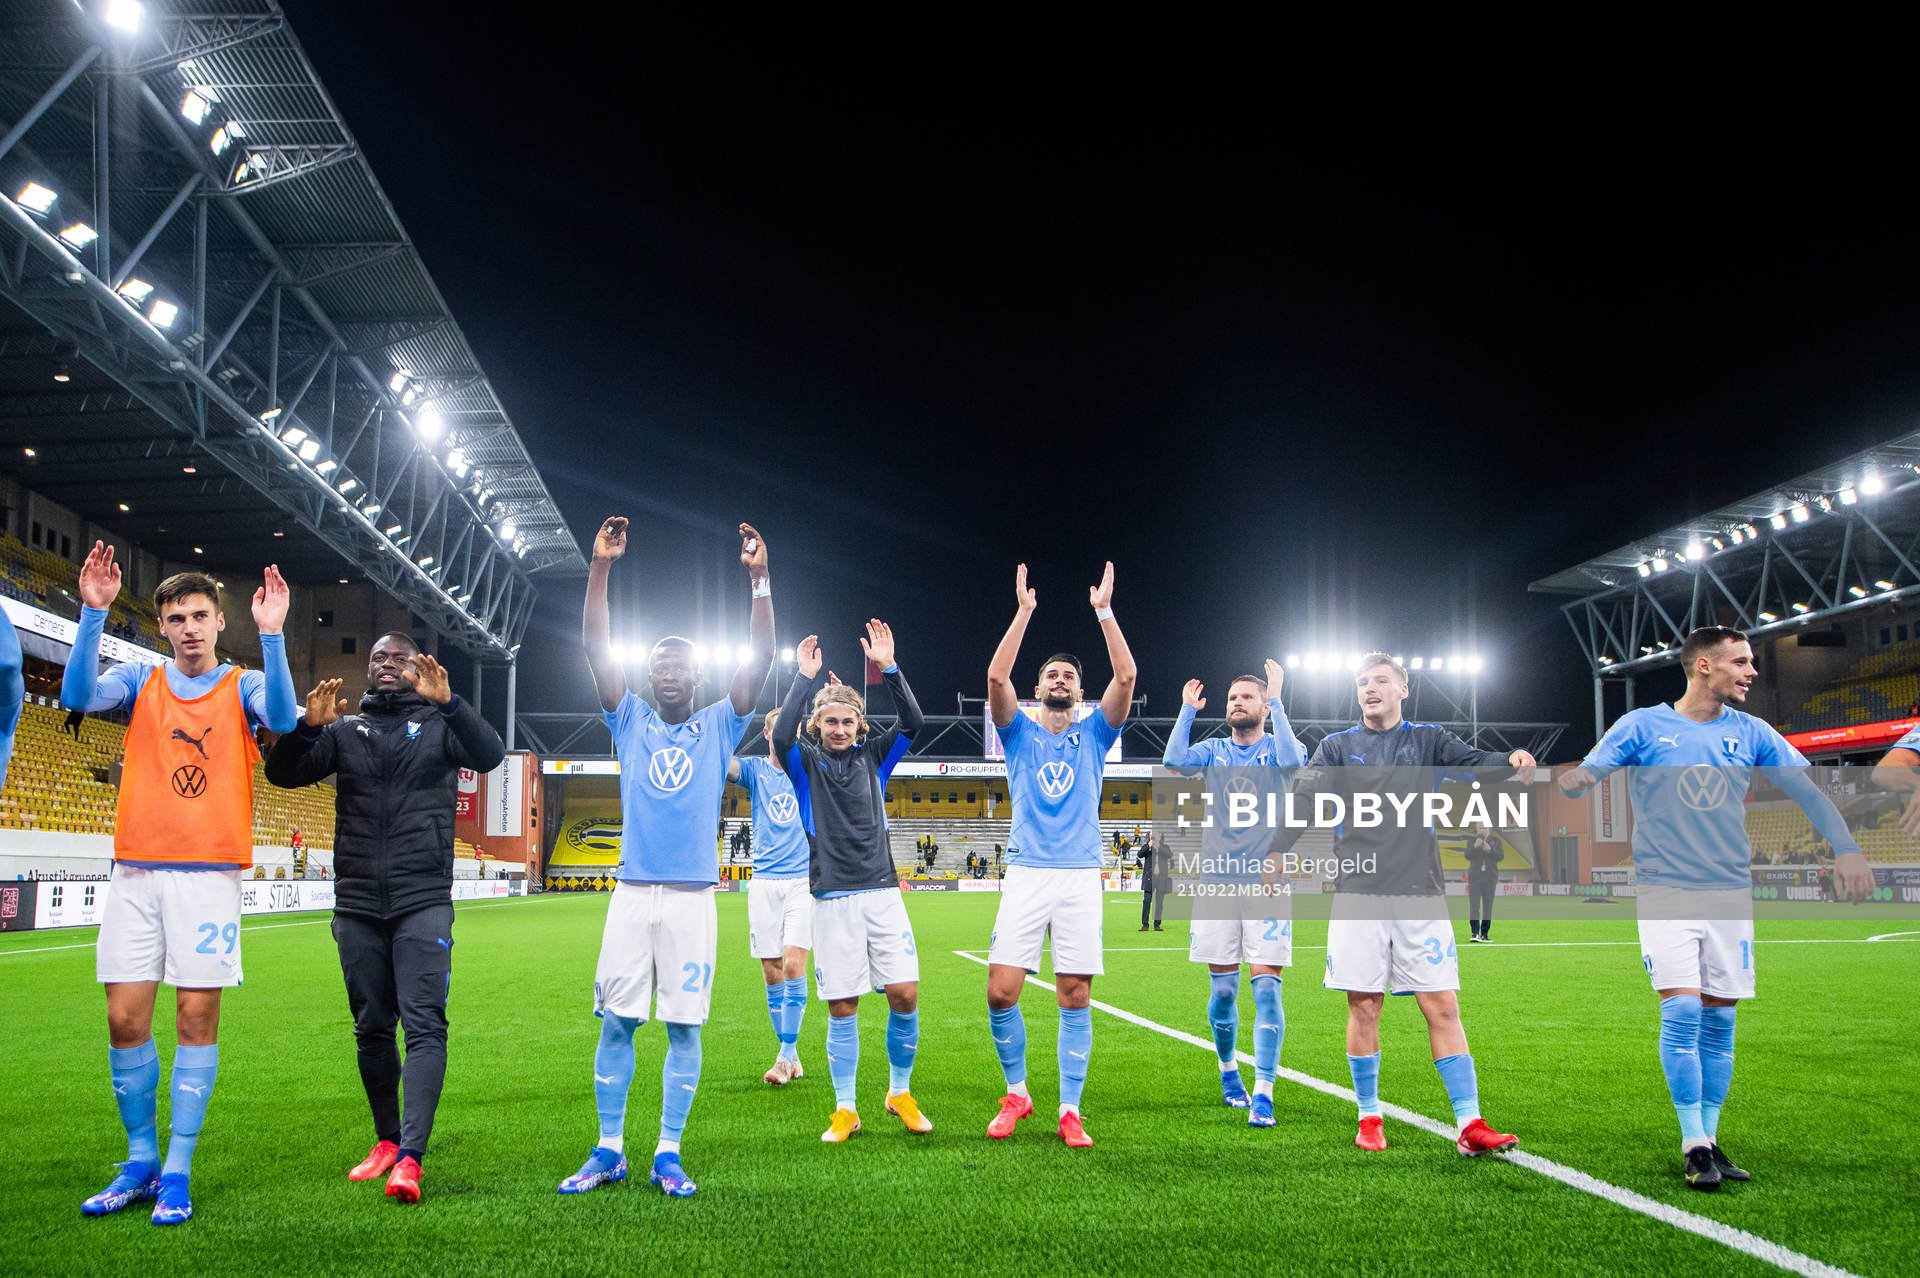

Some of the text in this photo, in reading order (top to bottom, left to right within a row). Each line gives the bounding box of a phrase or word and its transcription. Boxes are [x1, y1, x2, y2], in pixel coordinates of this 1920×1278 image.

[1539, 884, 1571, 895] UNIBET
[1612, 885, 1636, 897] UNIBE
[1786, 886, 1822, 900] UNIBE
[195, 922, 238, 954] 29
